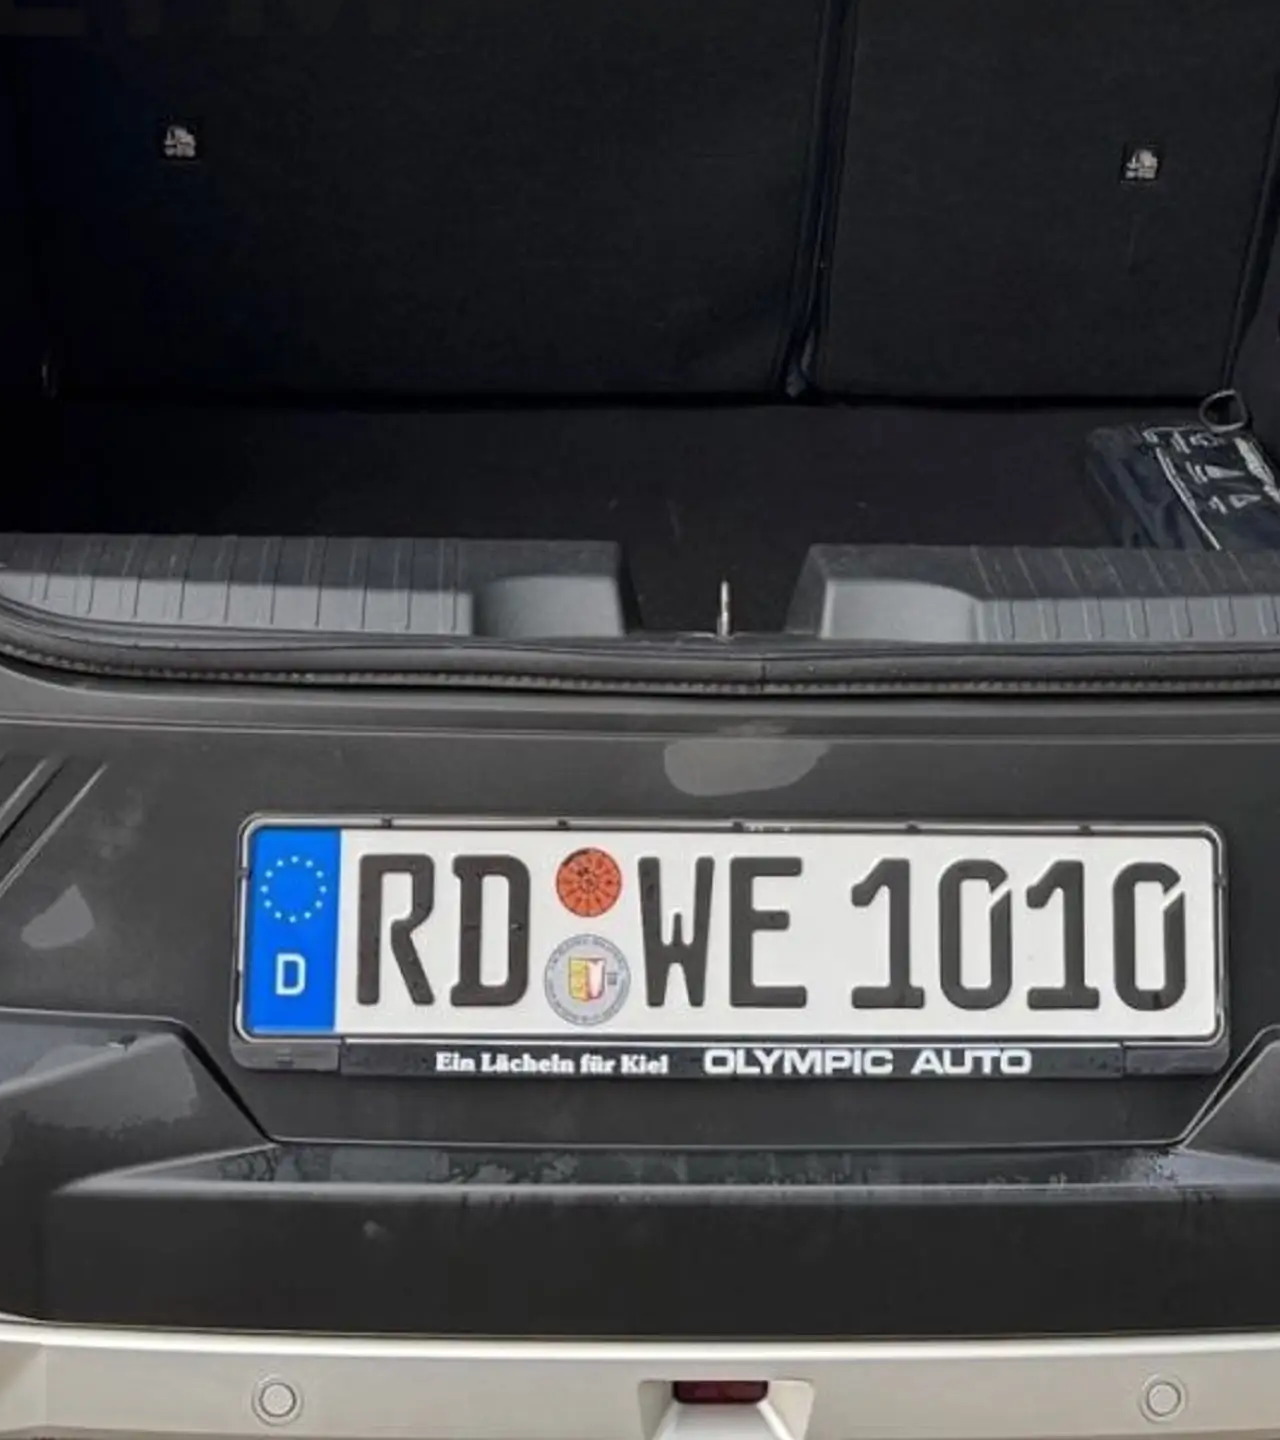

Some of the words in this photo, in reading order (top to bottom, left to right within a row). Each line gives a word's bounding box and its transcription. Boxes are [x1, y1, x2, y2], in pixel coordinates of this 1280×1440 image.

[357, 853, 531, 1007] RD
[638, 857, 807, 1007] WE
[851, 858, 1187, 1012] 1010
[275, 953, 307, 996] D
[435, 1051, 476, 1073] Ein
[480, 1052, 574, 1075] Lächeln
[579, 1052, 616, 1075] für
[620, 1053, 669, 1075] Kiel
[703, 1048, 894, 1076] OLYMPIC
[910, 1048, 1033, 1076] AUTO
